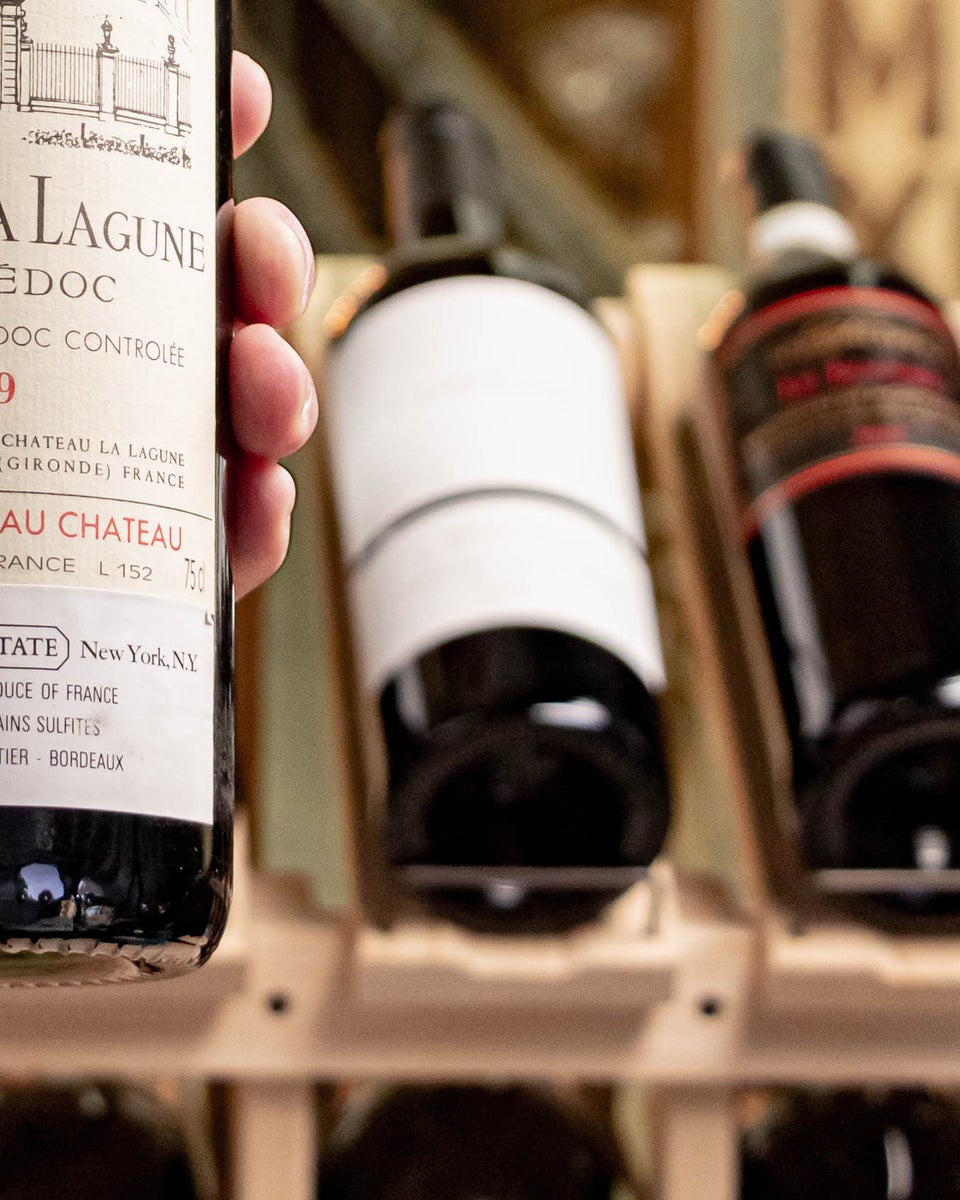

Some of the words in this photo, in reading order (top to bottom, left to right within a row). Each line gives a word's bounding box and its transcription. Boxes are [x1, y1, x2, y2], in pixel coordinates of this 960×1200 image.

[29, 175, 205, 272] LAGUNE
[65, 330, 184, 367] CONTROLÉE
[2, 434, 90, 452] CHATEAU
[100, 440, 120, 455] LA
[128, 444, 185, 467] LAGUNE
[123, 465, 185, 489] FRANCE
[0, 509, 44, 535] AU
[58, 511, 182, 551] CHATEAU
[100, 561, 109, 576] L
[117, 564, 152, 581] 152
[80, 640, 123, 661] New
[128, 644, 169, 671] York,
[42, 683, 60, 699] OF
[67, 684, 118, 704] FRANCE
[37, 716, 100, 736] SULFITES
[50, 750, 123, 771] BORDEAUX
